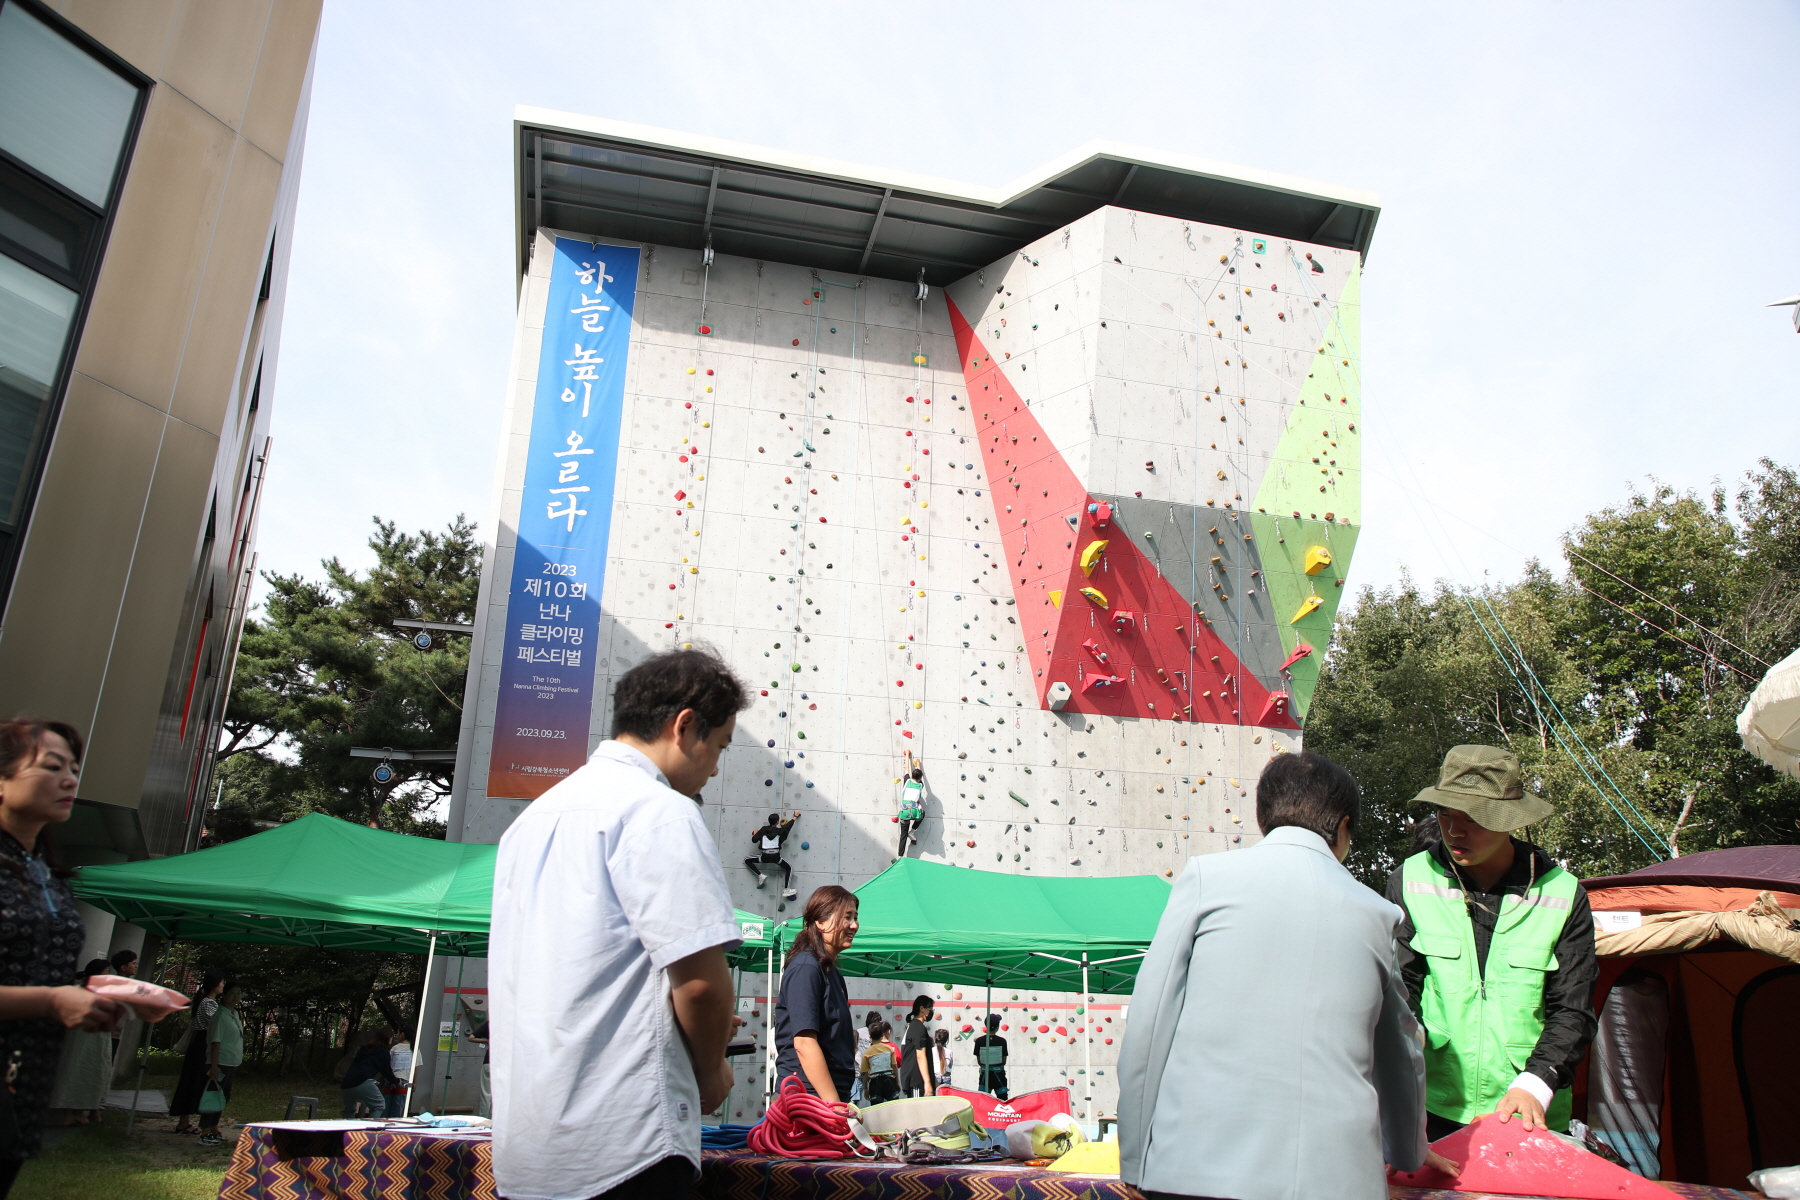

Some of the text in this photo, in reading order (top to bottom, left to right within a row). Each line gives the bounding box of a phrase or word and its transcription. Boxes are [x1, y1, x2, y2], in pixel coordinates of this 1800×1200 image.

[546, 260, 614, 533] 하늘 높이 오르다
[542, 562, 577, 577] 2023
[523, 578, 588, 601] 제10회
[539, 602, 572, 622] 난나
[519, 623, 584, 645] 클라이밍
[516, 646, 582, 667] 페스티벌
[532, 675, 561, 684] The 10th
[532, 684, 557, 693] Climbing
[537, 692, 554, 700] 2023
[516, 727, 567, 740] 2023.09.23.
